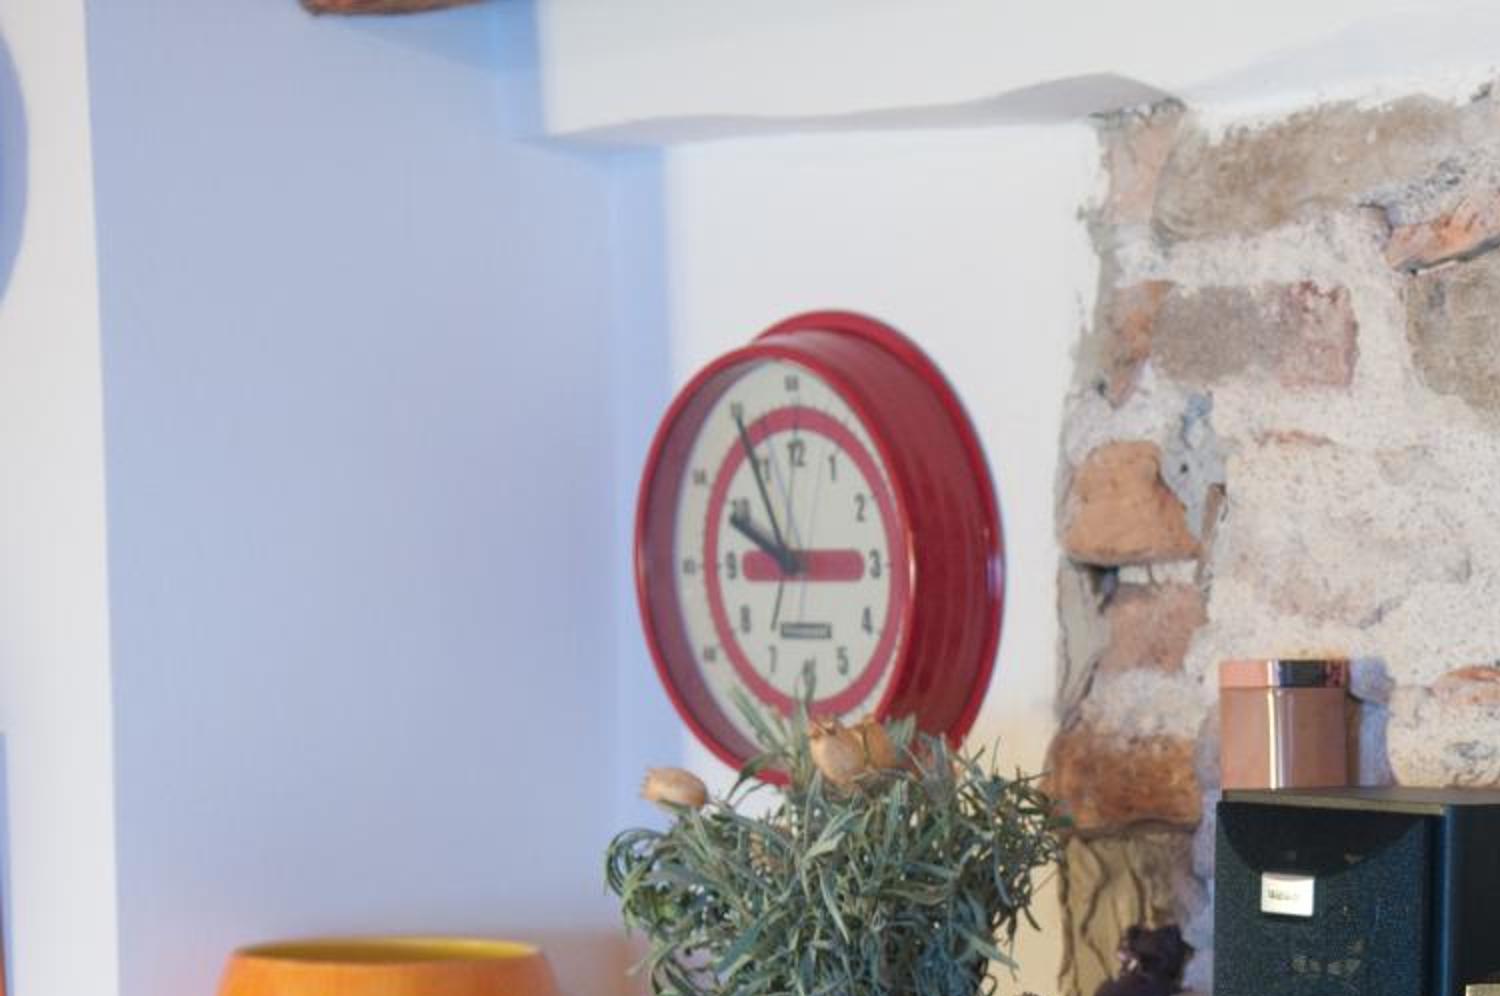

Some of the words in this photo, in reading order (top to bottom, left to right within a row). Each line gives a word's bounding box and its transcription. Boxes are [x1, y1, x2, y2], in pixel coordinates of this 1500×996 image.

[787, 439, 806, 468] 12
[827, 453, 837, 482] 1
[855, 491, 866, 523] 2
[869, 548, 881, 579] 3
[861, 604, 874, 635] 4
[836, 645, 849, 676] 5
